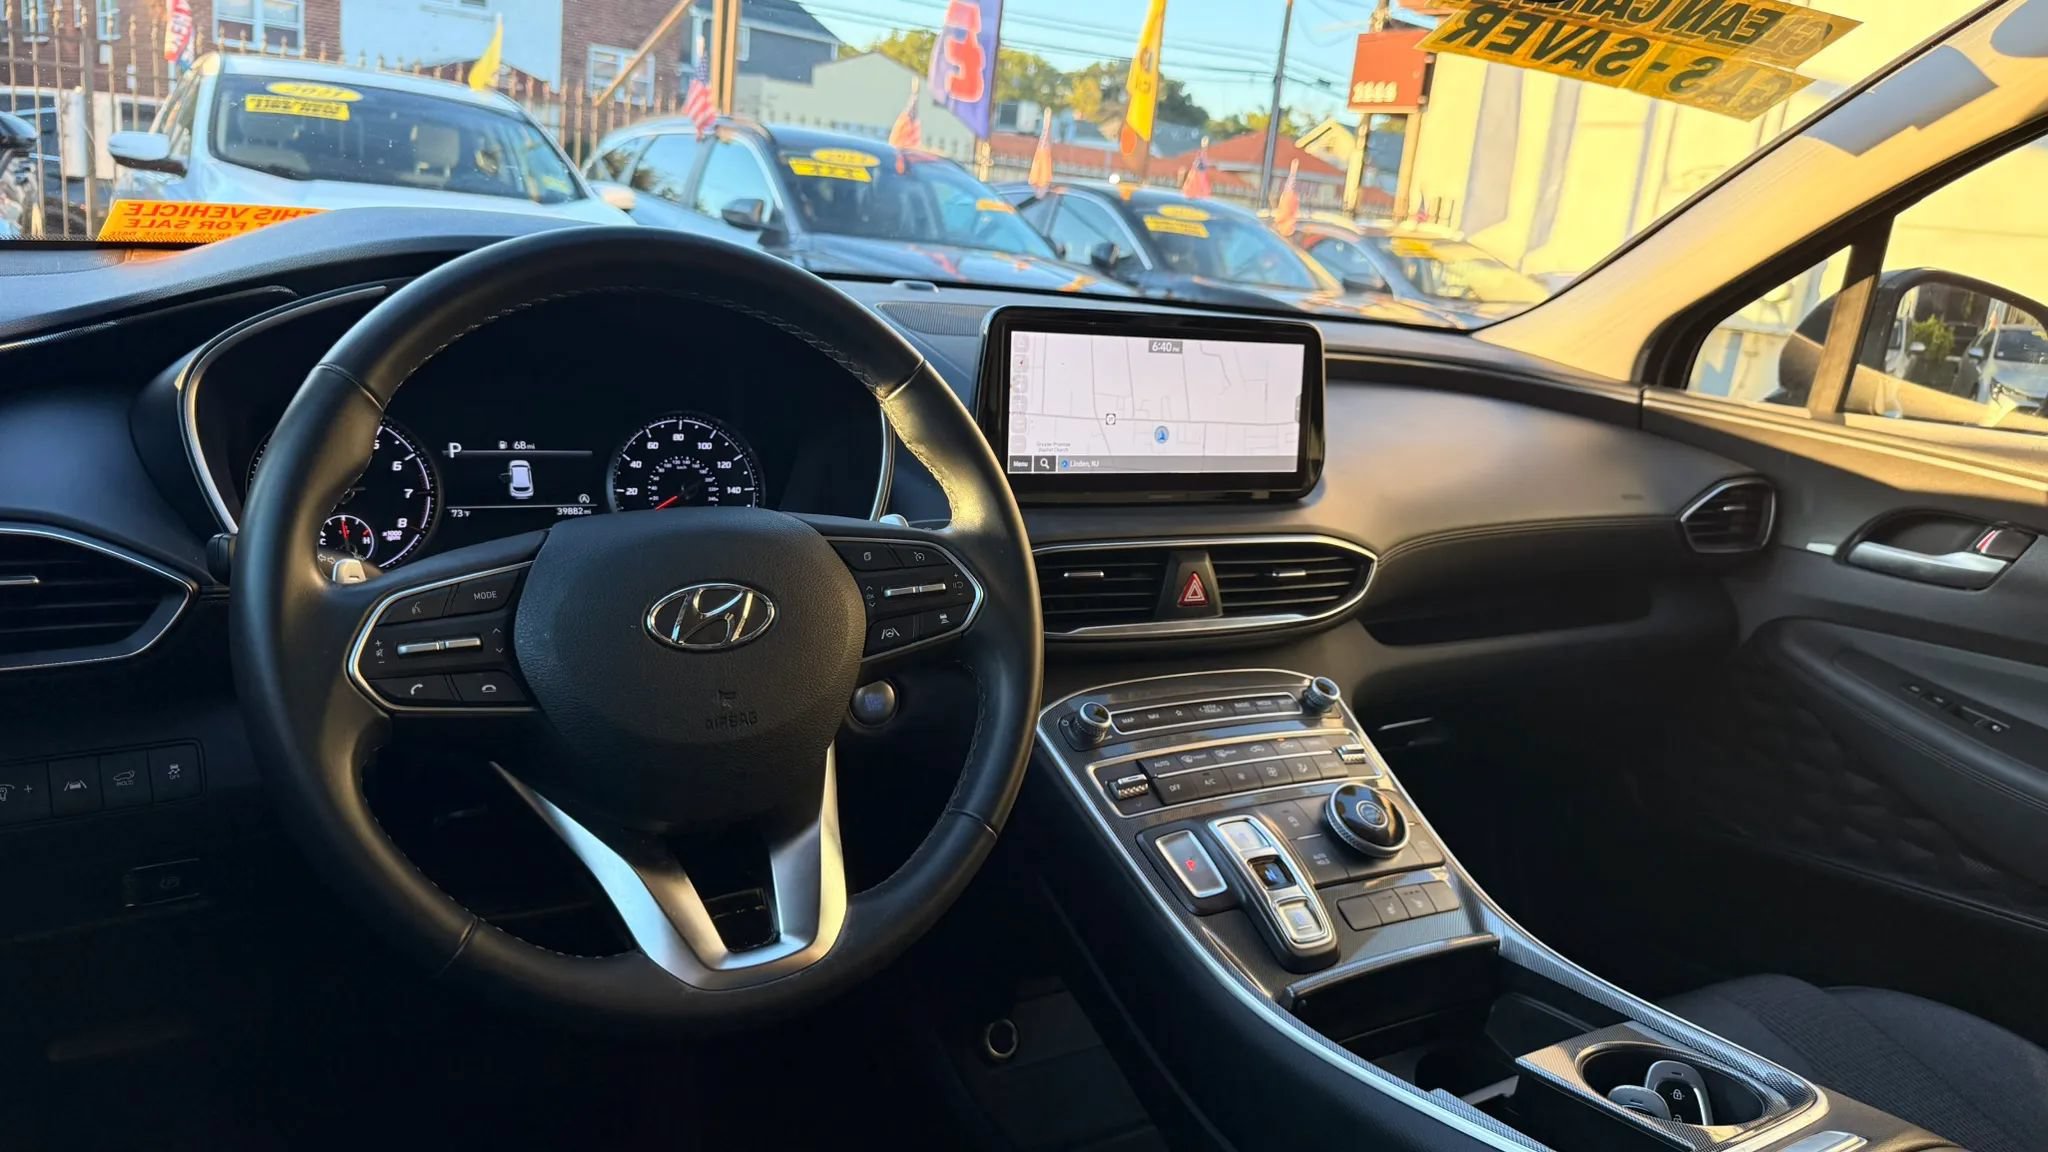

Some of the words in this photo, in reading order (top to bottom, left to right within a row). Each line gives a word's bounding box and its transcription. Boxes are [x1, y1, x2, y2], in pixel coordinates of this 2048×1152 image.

[1151, 341, 1172, 352] 6:40
[672, 433, 684, 441] 80
[448, 442, 462, 458] P
[392, 461, 402, 470] 6
[1070, 460, 1091, 468] Linden,
[404, 488, 413, 498] 7
[397, 518, 408, 528] 8
[473, 590, 497, 600] MODE
